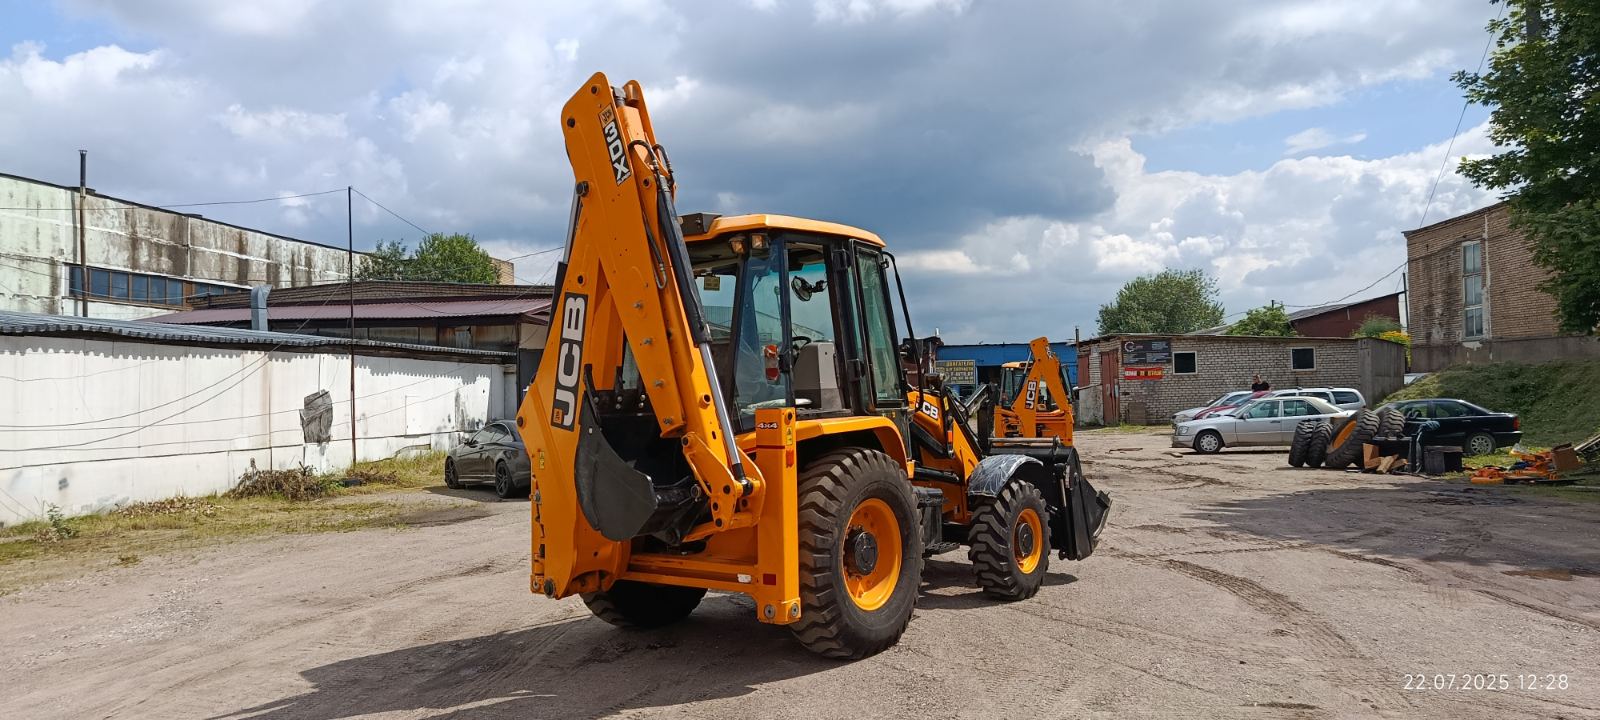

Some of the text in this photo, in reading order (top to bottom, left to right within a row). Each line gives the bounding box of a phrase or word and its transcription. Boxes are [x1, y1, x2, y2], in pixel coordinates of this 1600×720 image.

[604, 121, 629, 181] 3DX
[556, 297, 585, 426] JCB
[1026, 381, 1037, 409] JCB
